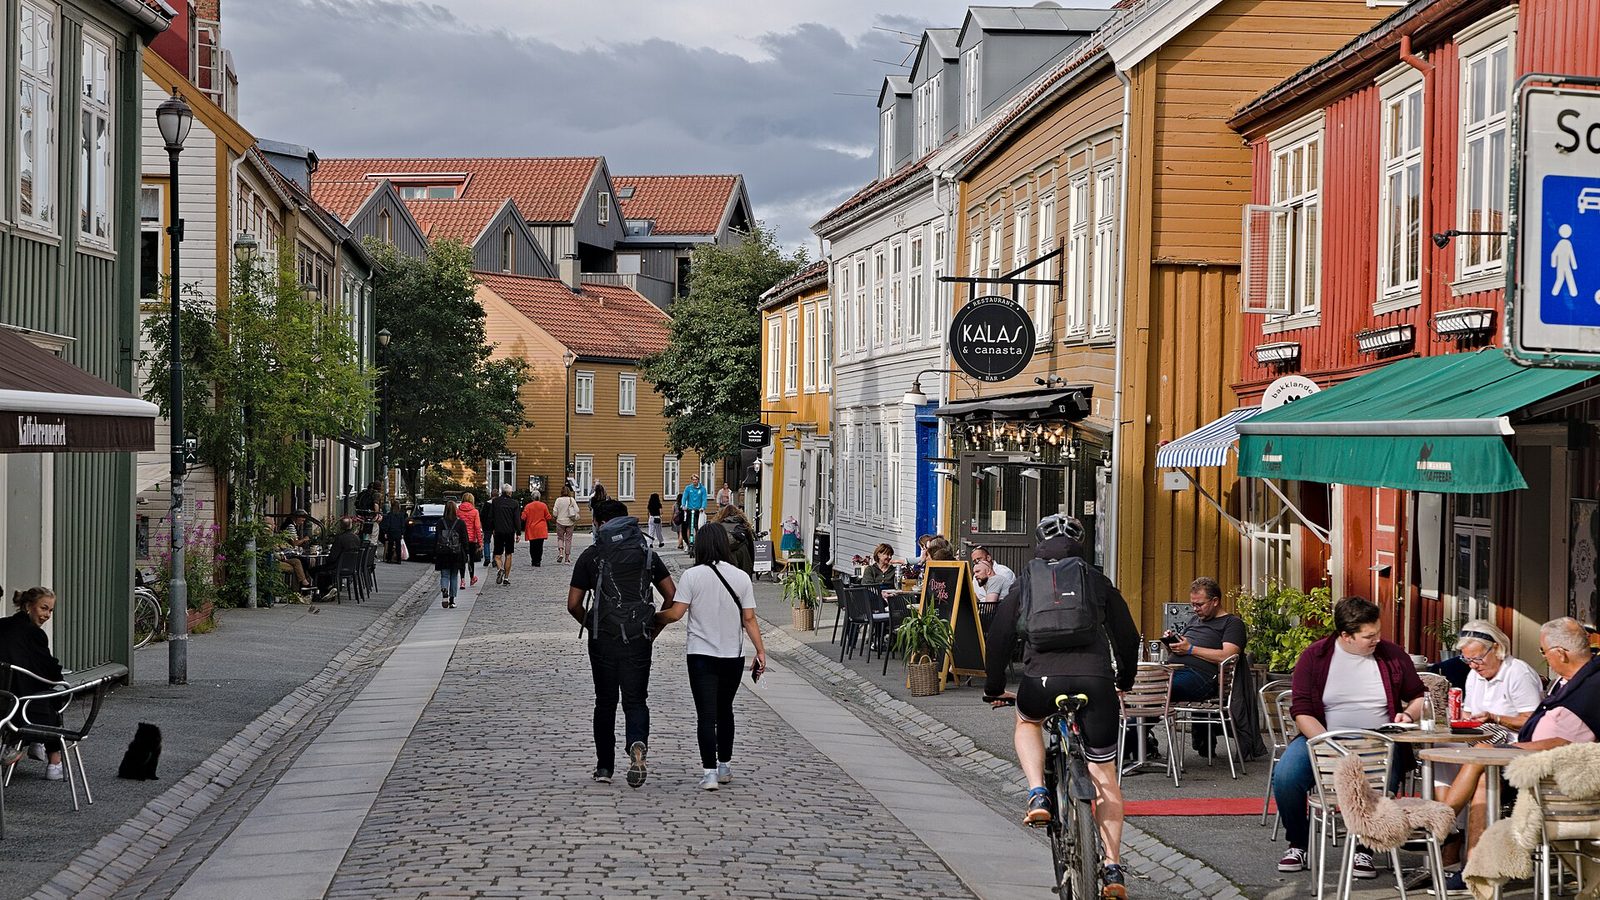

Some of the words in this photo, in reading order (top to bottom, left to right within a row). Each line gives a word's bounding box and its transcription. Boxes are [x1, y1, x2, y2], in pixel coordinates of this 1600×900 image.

[973, 297, 1015, 307] RESTAURANT
[963, 324, 1023, 343] KALAS
[962, 346, 969, 354] &
[974, 347, 1023, 355] canasta
